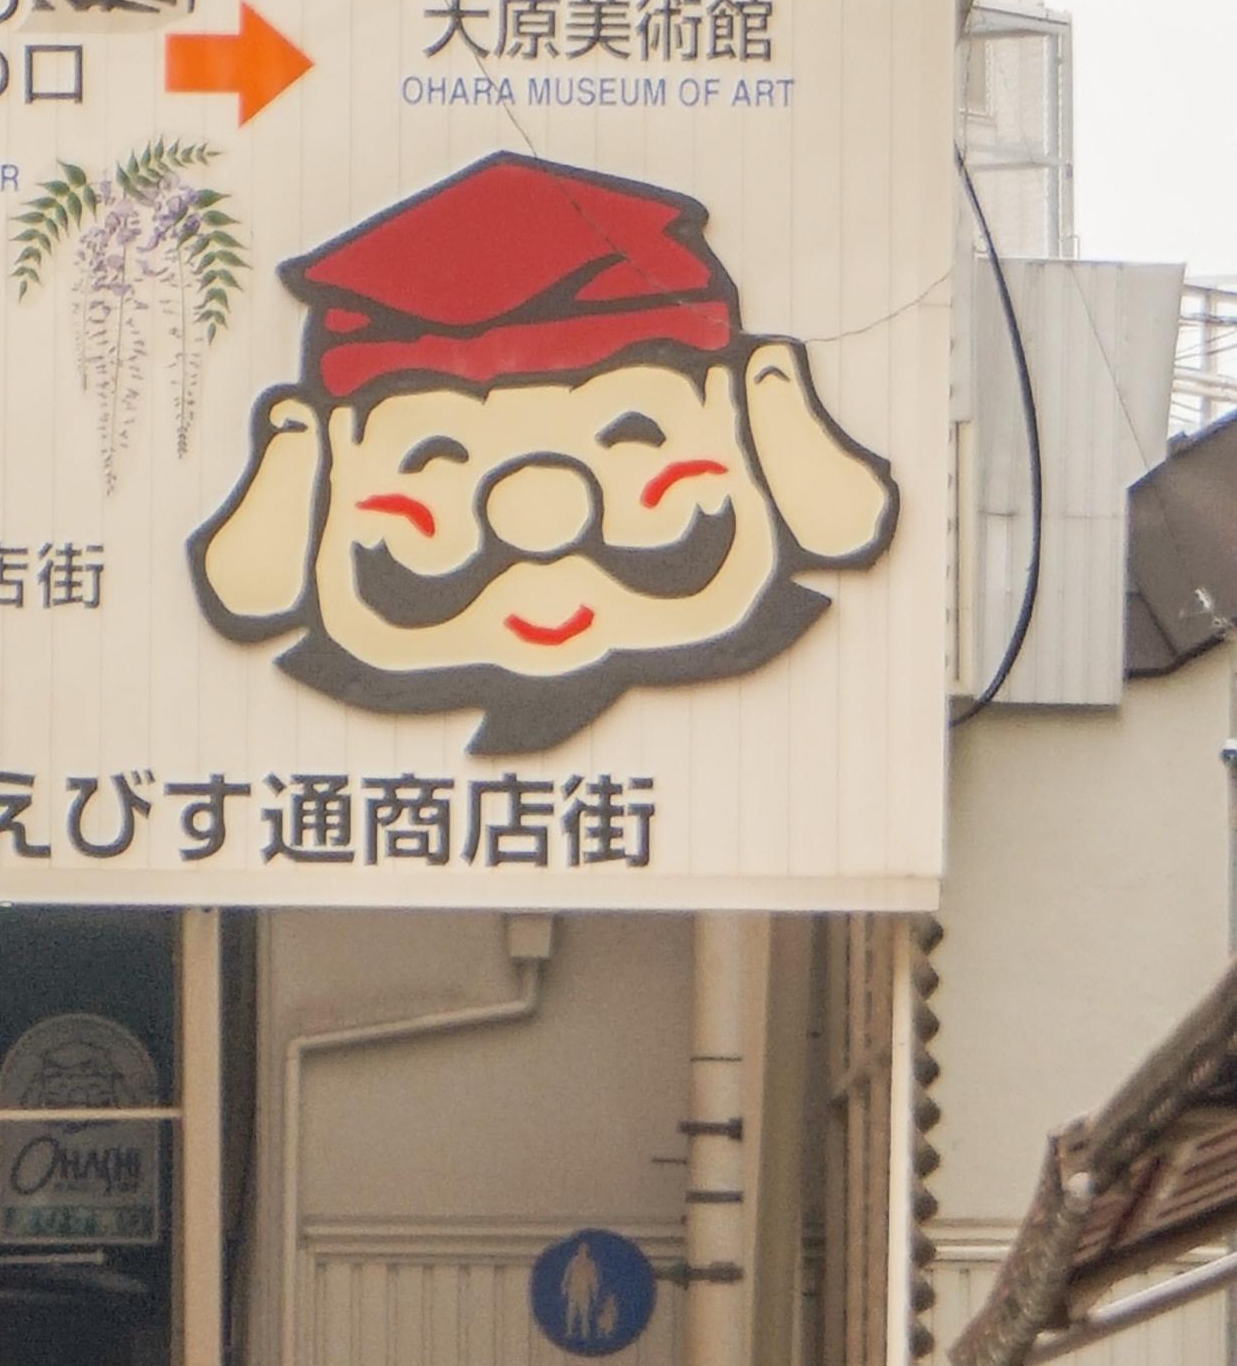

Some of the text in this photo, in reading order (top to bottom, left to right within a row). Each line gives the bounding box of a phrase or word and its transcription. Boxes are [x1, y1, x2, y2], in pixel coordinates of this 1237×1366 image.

[402, 76, 795, 108] OHARA MUSEUM OF ART
